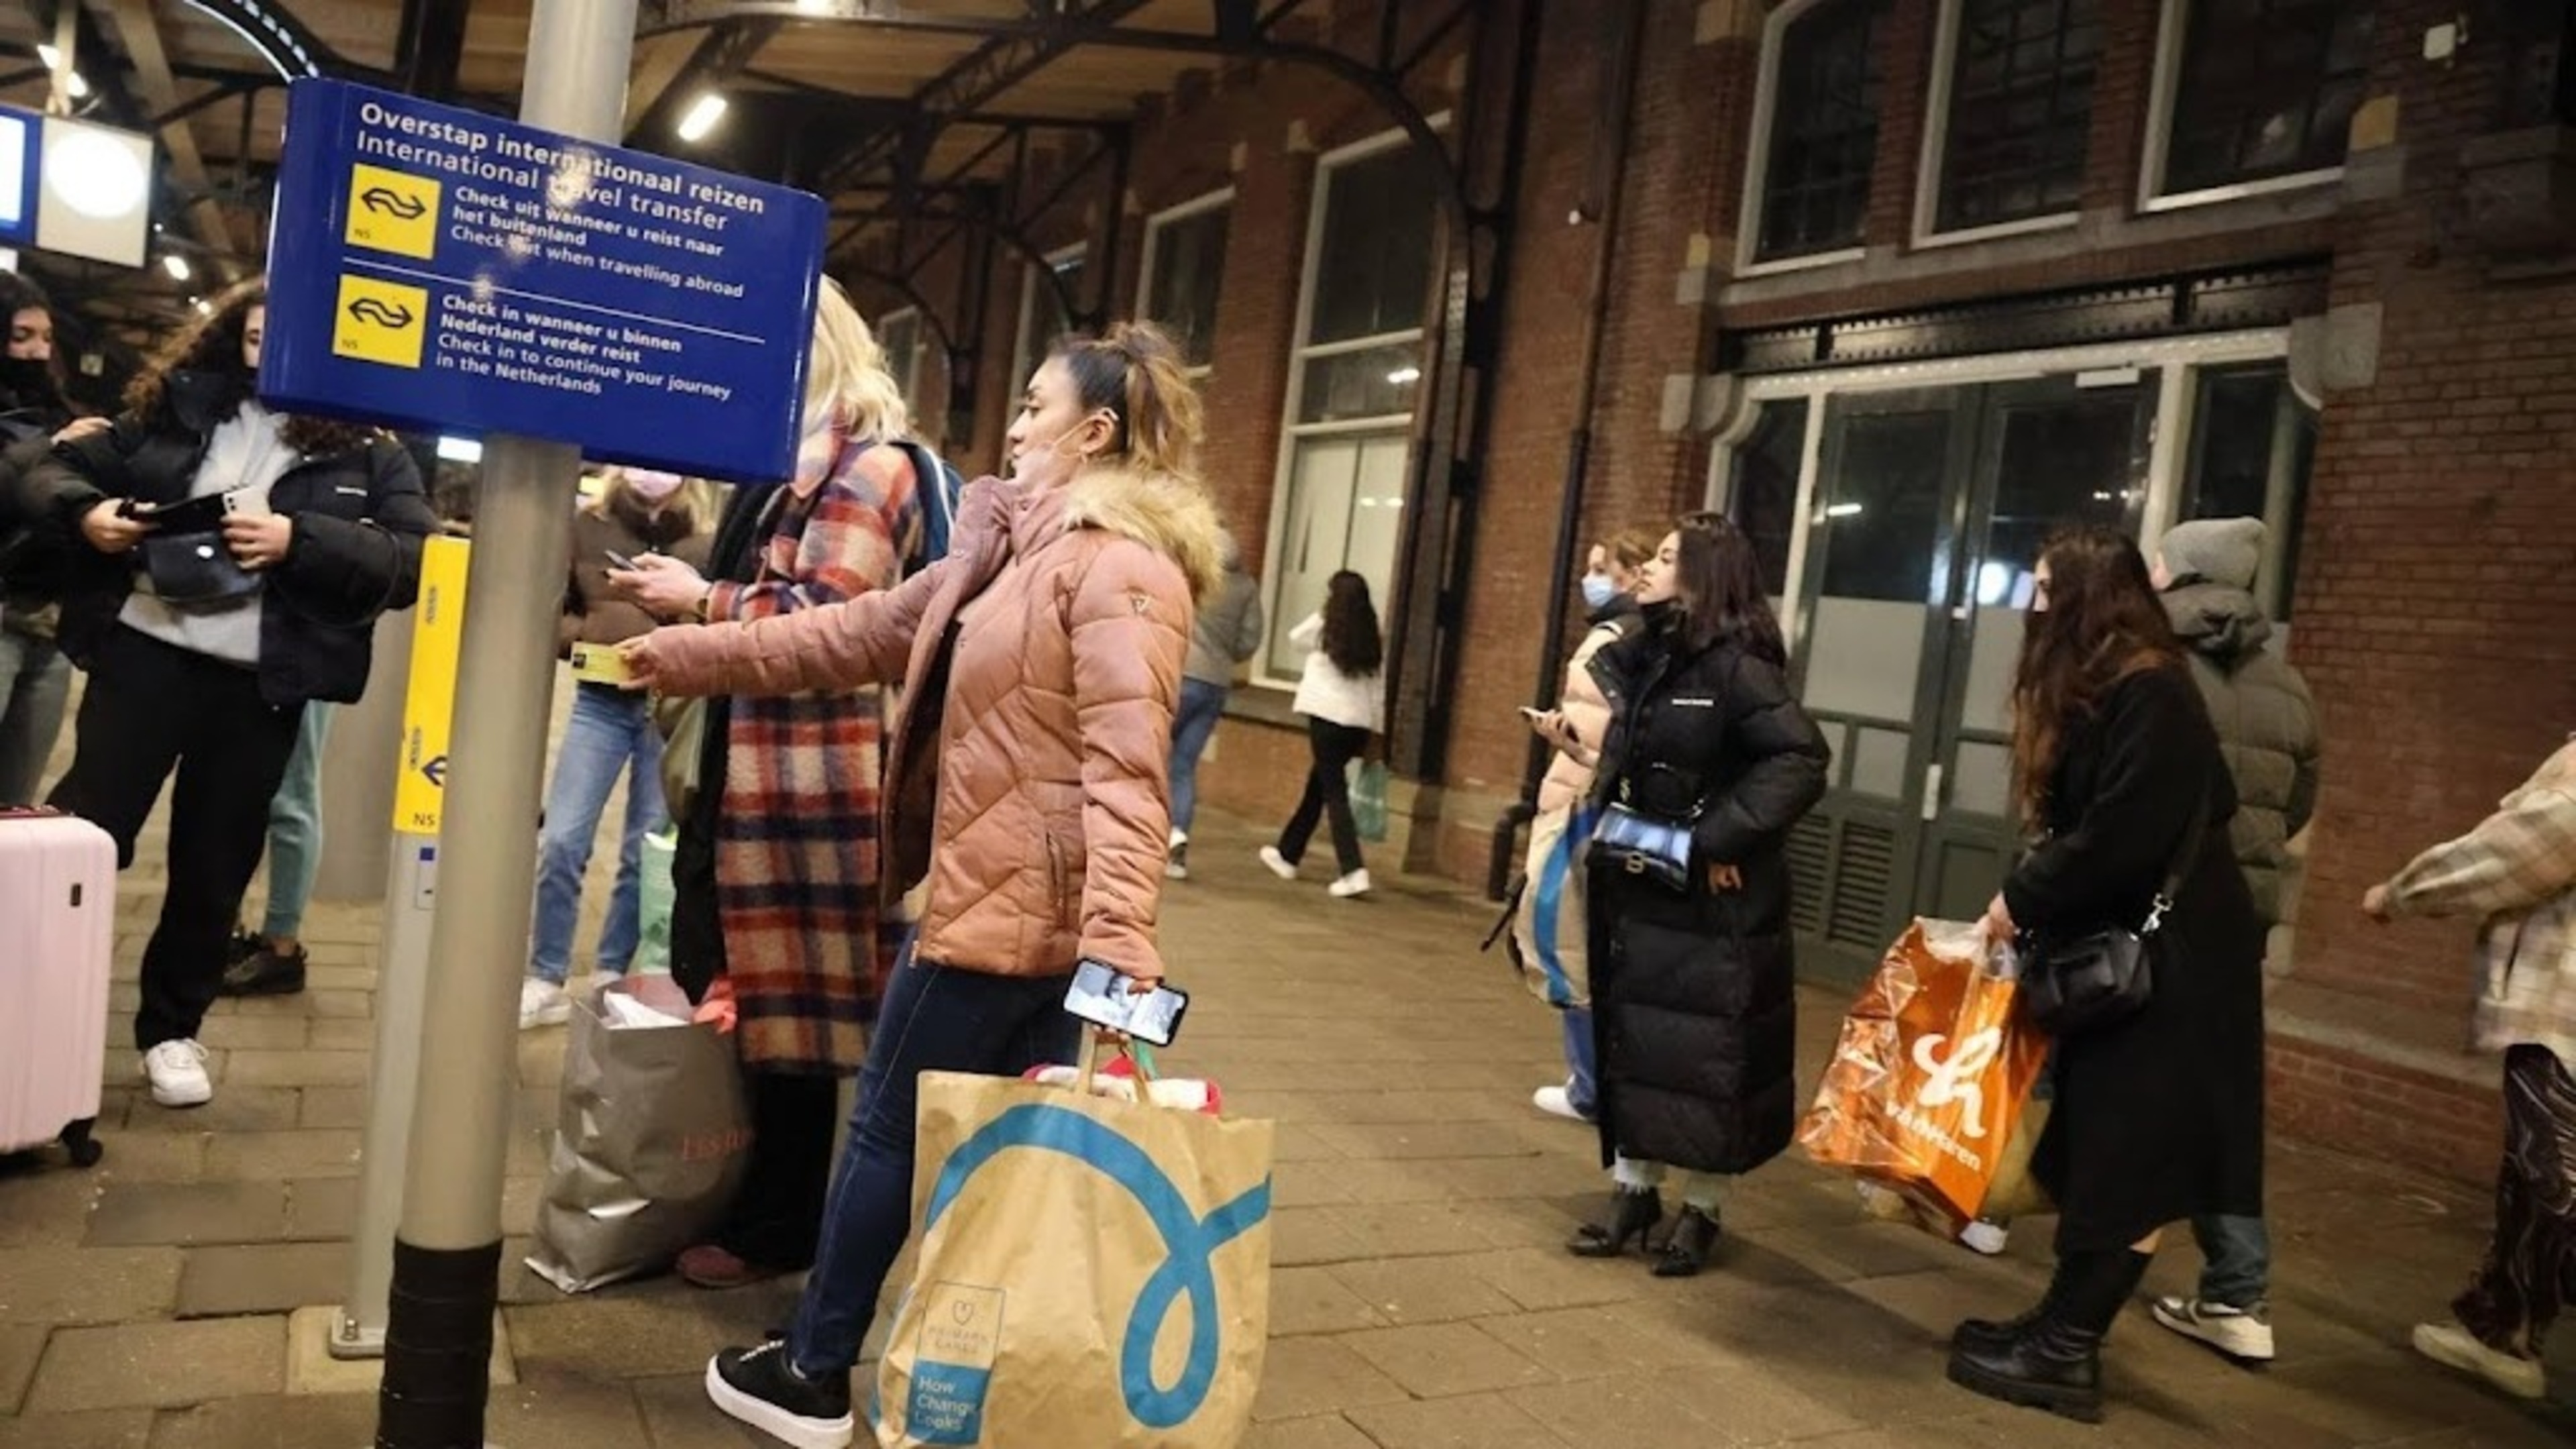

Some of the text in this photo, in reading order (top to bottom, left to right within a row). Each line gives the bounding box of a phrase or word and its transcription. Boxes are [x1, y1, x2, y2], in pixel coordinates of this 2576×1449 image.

[357, 130, 538, 189] International
[630, 194, 729, 230] transfer
[361, 103, 765, 214] Overstap internationaal reizen
[452, 205, 587, 246] het buitenland
[455, 186, 724, 256] Check uit wanneer u reist naar
[450, 225, 504, 248] Check
[545, 246, 594, 268] when
[599, 256, 680, 288] travelling
[685, 274, 744, 298] abroad
[440, 313, 641, 363] Nederland verder reist
[442, 294, 682, 352] Check in wanneer u binnen
[436, 351, 602, 394] in the Netherlands
[437, 333, 731, 401] Check in to continue your journey
[413, 812, 436, 826] NS
[919, 1376, 956, 1394] How
